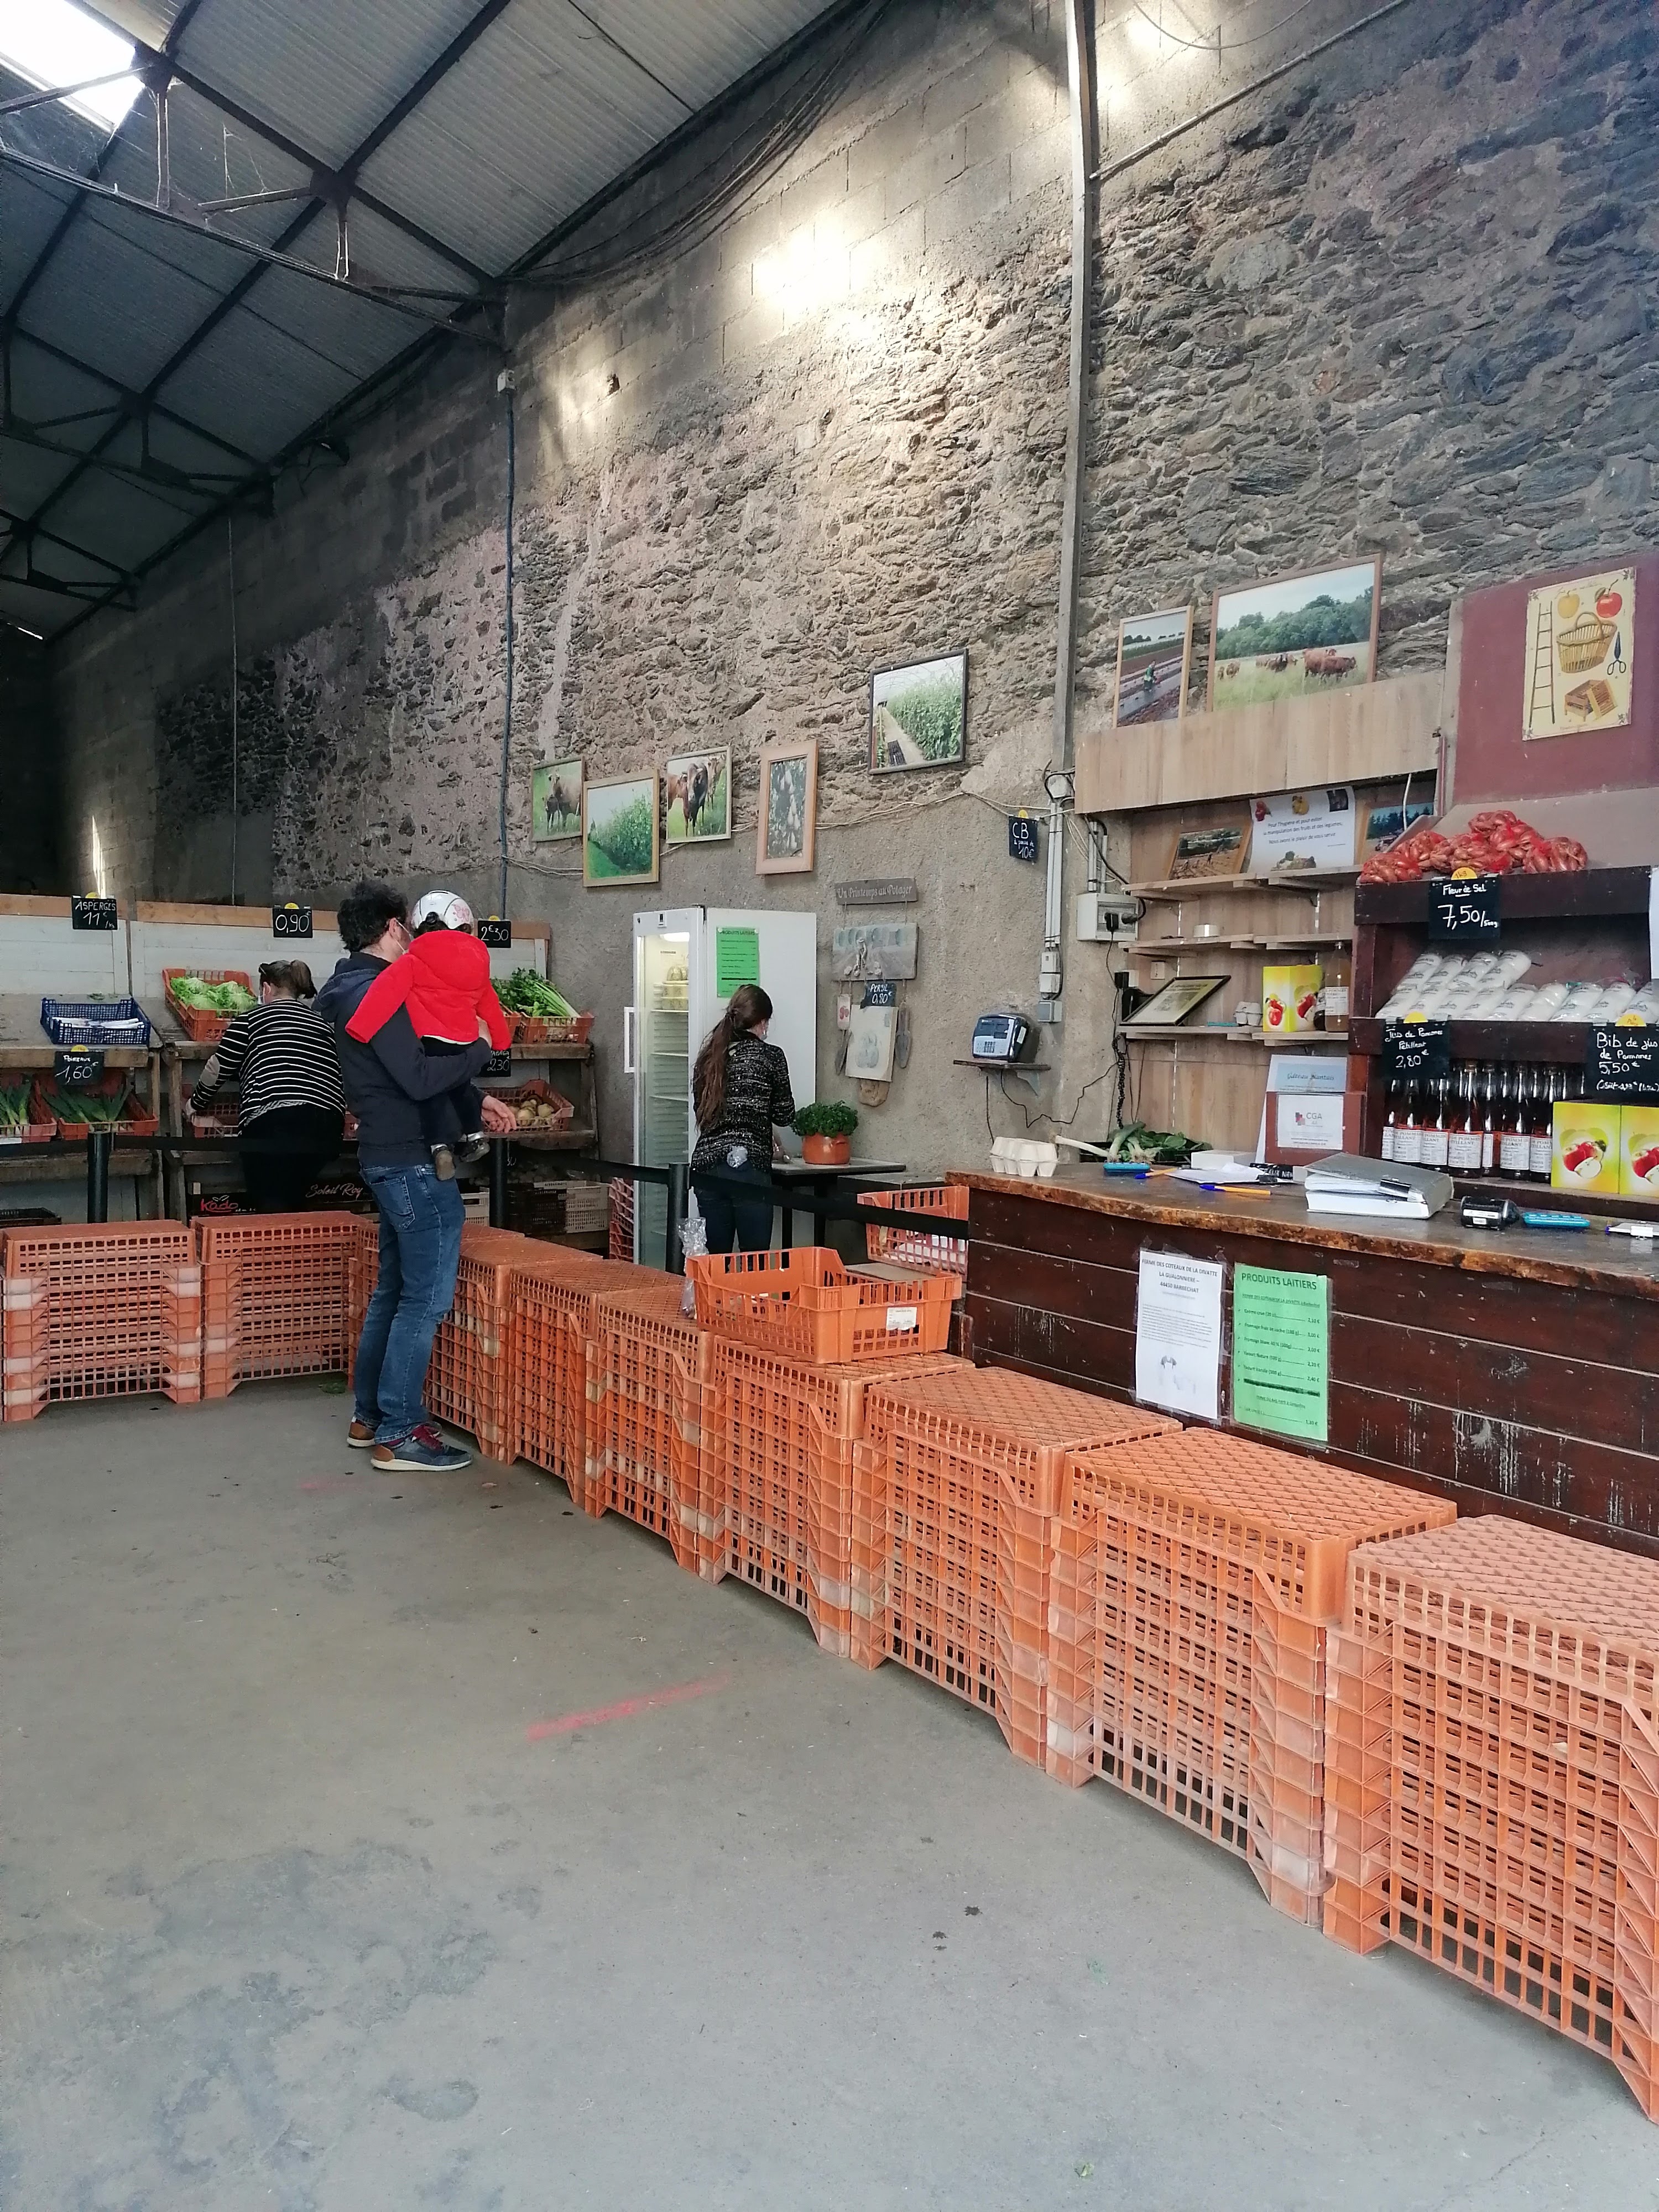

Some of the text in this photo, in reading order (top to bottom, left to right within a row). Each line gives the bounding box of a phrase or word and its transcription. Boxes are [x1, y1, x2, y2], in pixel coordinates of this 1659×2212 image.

[1013, 822, 1029, 839] CB
[1018, 846, 1035, 858] 10€
[838, 888, 847, 898] Un
[848, 886, 878, 900] Printemps
[887, 885, 912, 898] Potager
[1443, 884, 1462, 895] Fleur
[1473, 884, 1486, 892] Sel
[75, 901, 116, 911] ASPERGES
[1597, 1032, 1658, 1050] Bib de jus
[1600, 1048, 1652, 1060] de Pommes
[340, 1183, 364, 1201] Roy
[1241, 1272, 1317, 1290] PRODUITS LAITIERS
[1173, 1284, 1199, 1293] BARBECHAT
